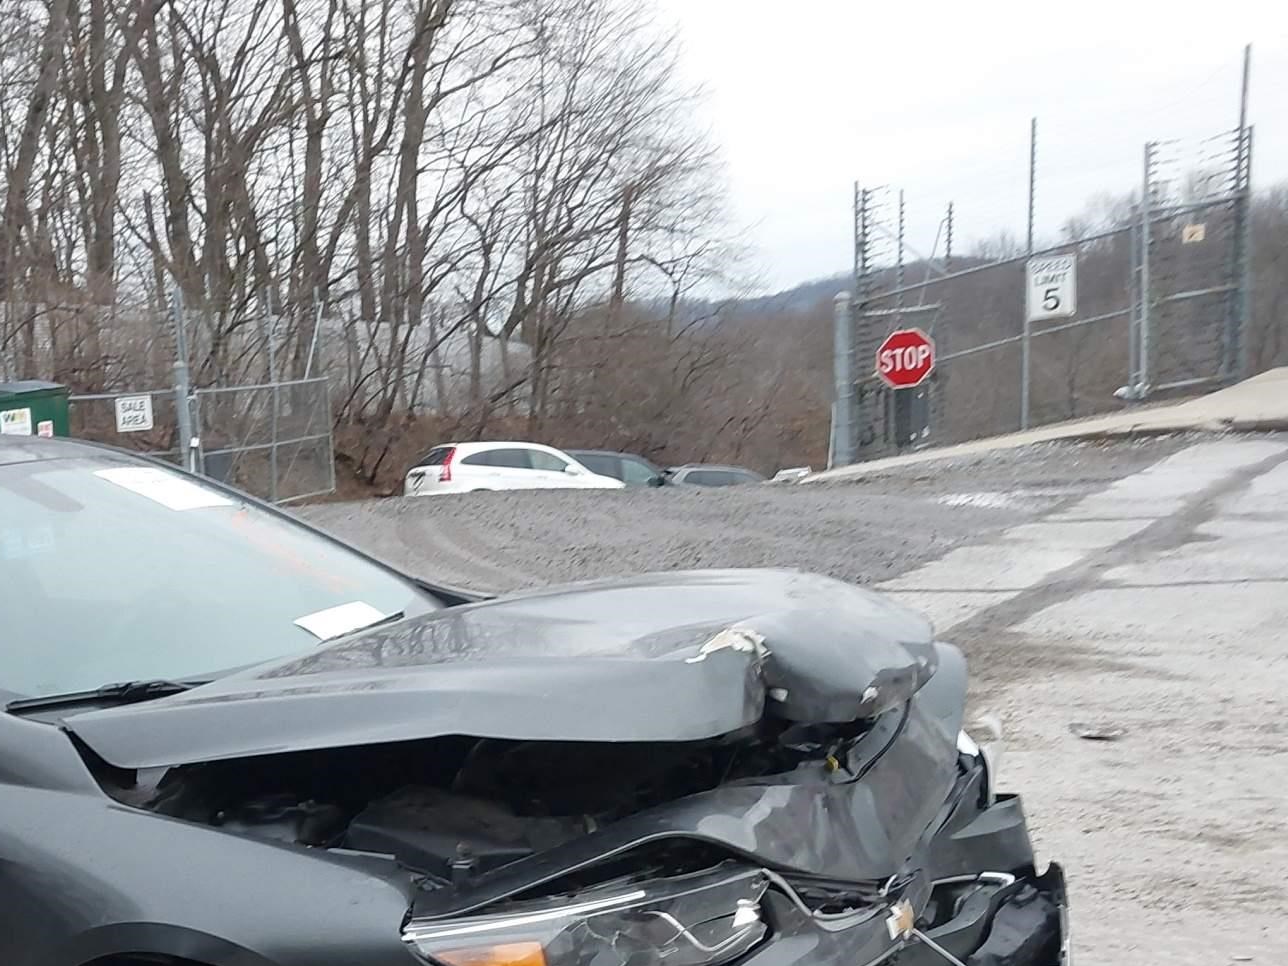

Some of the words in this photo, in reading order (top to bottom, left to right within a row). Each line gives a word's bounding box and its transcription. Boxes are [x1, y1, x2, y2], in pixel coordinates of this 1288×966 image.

[1042, 286, 1060, 311] 5
[879, 344, 930, 374] STOP
[120, 400, 145, 413] SALE
[121, 415, 146, 427] AREA
